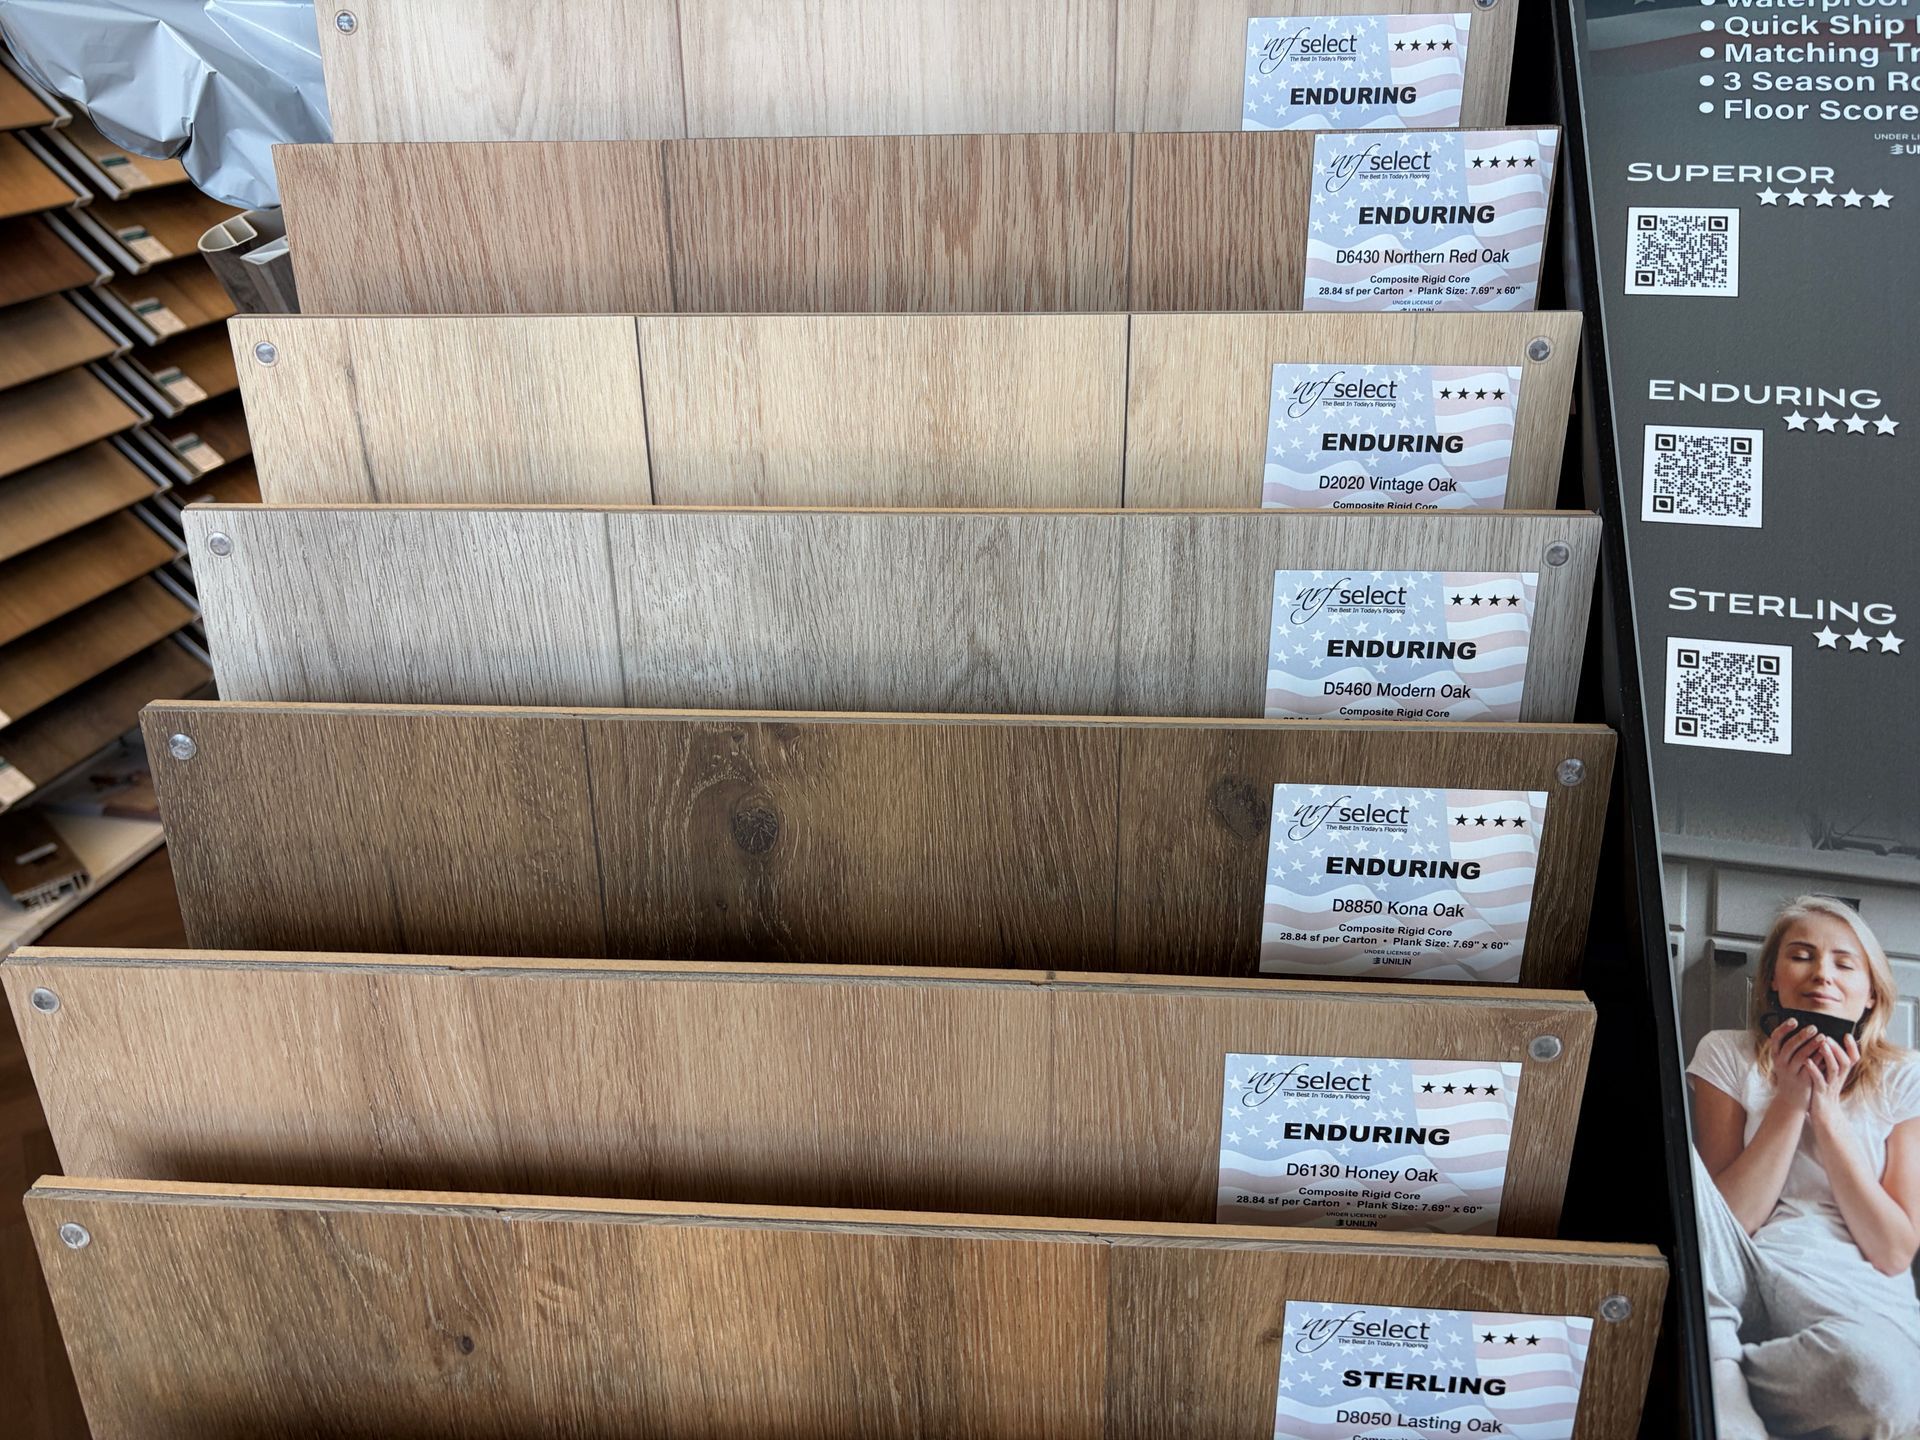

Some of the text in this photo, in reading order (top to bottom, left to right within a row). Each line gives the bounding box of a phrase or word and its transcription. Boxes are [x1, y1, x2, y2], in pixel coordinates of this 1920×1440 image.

[1724, 15, 1820, 37] Quick
[1829, 14, 1904, 39] Ship
[1259, 27, 1357, 74] nrf select
[1724, 42, 1879, 68] Matching
[1723, 72, 1742, 91] 3
[1752, 71, 1875, 92] Season
[1290, 87, 1416, 105] ENDURING
[1724, 99, 1919, 120] Floor Score
[1325, 143, 1431, 193] nrf select
[1627, 162, 1835, 184] SUPERIOR
[1359, 206, 1495, 225] ENDURING
[1336, 249, 1510, 264] D6430 Northern Red Oak
[1370, 275, 1470, 285] Composite Rigid Core
[1319, 287, 1342, 295] 28.84
[1345, 286, 1354, 295] sf
[1356, 288, 1370, 297] per
[1374, 287, 1404, 295] Carton
[1418, 287, 1443, 295] Plank
[1446, 286, 1468, 295] Size:
[1471, 286, 1494, 295] 7.69"
[1505, 286, 1521, 295] 60"
[1287, 371, 1398, 418] nrf select
[1649, 379, 1882, 409] ENDURING
[1322, 433, 1463, 453] ENDURING
[1319, 475, 1456, 493] D2020 Vintage Oak
[1333, 500, 1385, 508] Composite
[1291, 578, 1407, 625] nrf select
[1668, 586, 1897, 625] STERLING
[1327, 640, 1476, 660] ENDURING
[1323, 681, 1470, 699] D5460 Modern Oak
[1339, 707, 1393, 717] Composite
[1396, 708, 1423, 719] Rigid
[1426, 709, 1450, 718] Core
[1288, 796, 1409, 841] nrf select
[1384, 826, 1408, 834] Flooring
[1326, 856, 1480, 880] ENDURING
[1333, 899, 1465, 918] D8850 Kona Oak
[1338, 923, 1452, 937] Composite Rigid Core
[1280, 932, 1307, 942] 28.84
[1310, 933, 1320, 942] sf
[1322, 935, 1340, 944] per
[1343, 935, 1377, 945] Carton
[1393, 937, 1423, 947] Plank
[1425, 938, 1450, 948] Size:
[1453, 939, 1480, 949] 7.69"
[1490, 941, 1509, 950] 60"
[1382, 957, 1412, 966] UNILIN
[1242, 1063, 1372, 1107] nrf select
[1320, 1092, 1344, 1100] Today's
[1345, 1093, 1370, 1101] Flooring
[1284, 1122, 1450, 1146] ENDURING
[1286, 1163, 1439, 1183] D6130 Honey Oak
[1298, 1187, 1421, 1200] Composite Rigid Core
[1236, 1195, 1265, 1204] 28.84
[1268, 1196, 1278, 1205] sf
[1281, 1198, 1300, 1207] per
[1302, 1198, 1340, 1208] Carton
[1357, 1200, 1390, 1210] Plank
[1392, 1201, 1418, 1212] Size:
[1422, 1203, 1450, 1212] 7.69"
[1463, 1204, 1482, 1214] 60"
[1346, 1219, 1377, 1228] UNILIN
[1295, 1311, 1430, 1353] nrf select
[1377, 1340, 1401, 1348] Today's
[1402, 1340, 1428, 1349] Flooring
[1342, 1370, 1506, 1396] STERLING
[1336, 1410, 1503, 1434] D8050 Lasting Oak
